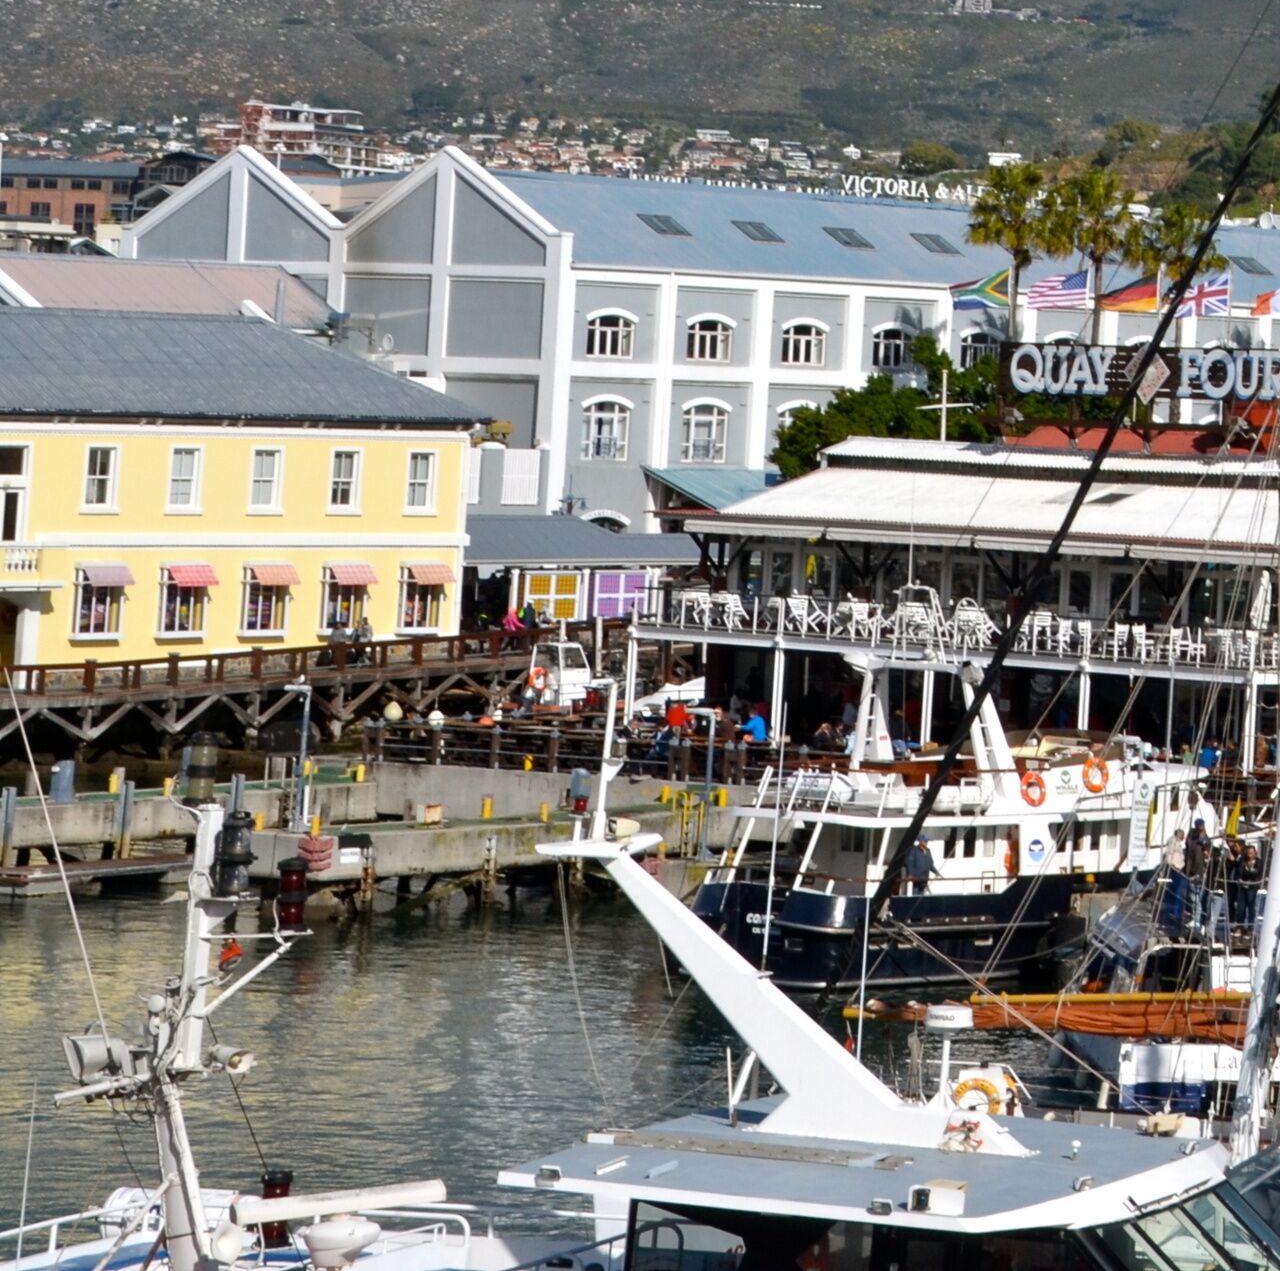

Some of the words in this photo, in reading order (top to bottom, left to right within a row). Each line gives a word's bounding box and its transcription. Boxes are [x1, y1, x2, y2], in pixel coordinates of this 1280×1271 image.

[842, 175, 929, 198] VICTORIA
[935, 183, 949, 199] &
[1010, 344, 1116, 395] QUAY
